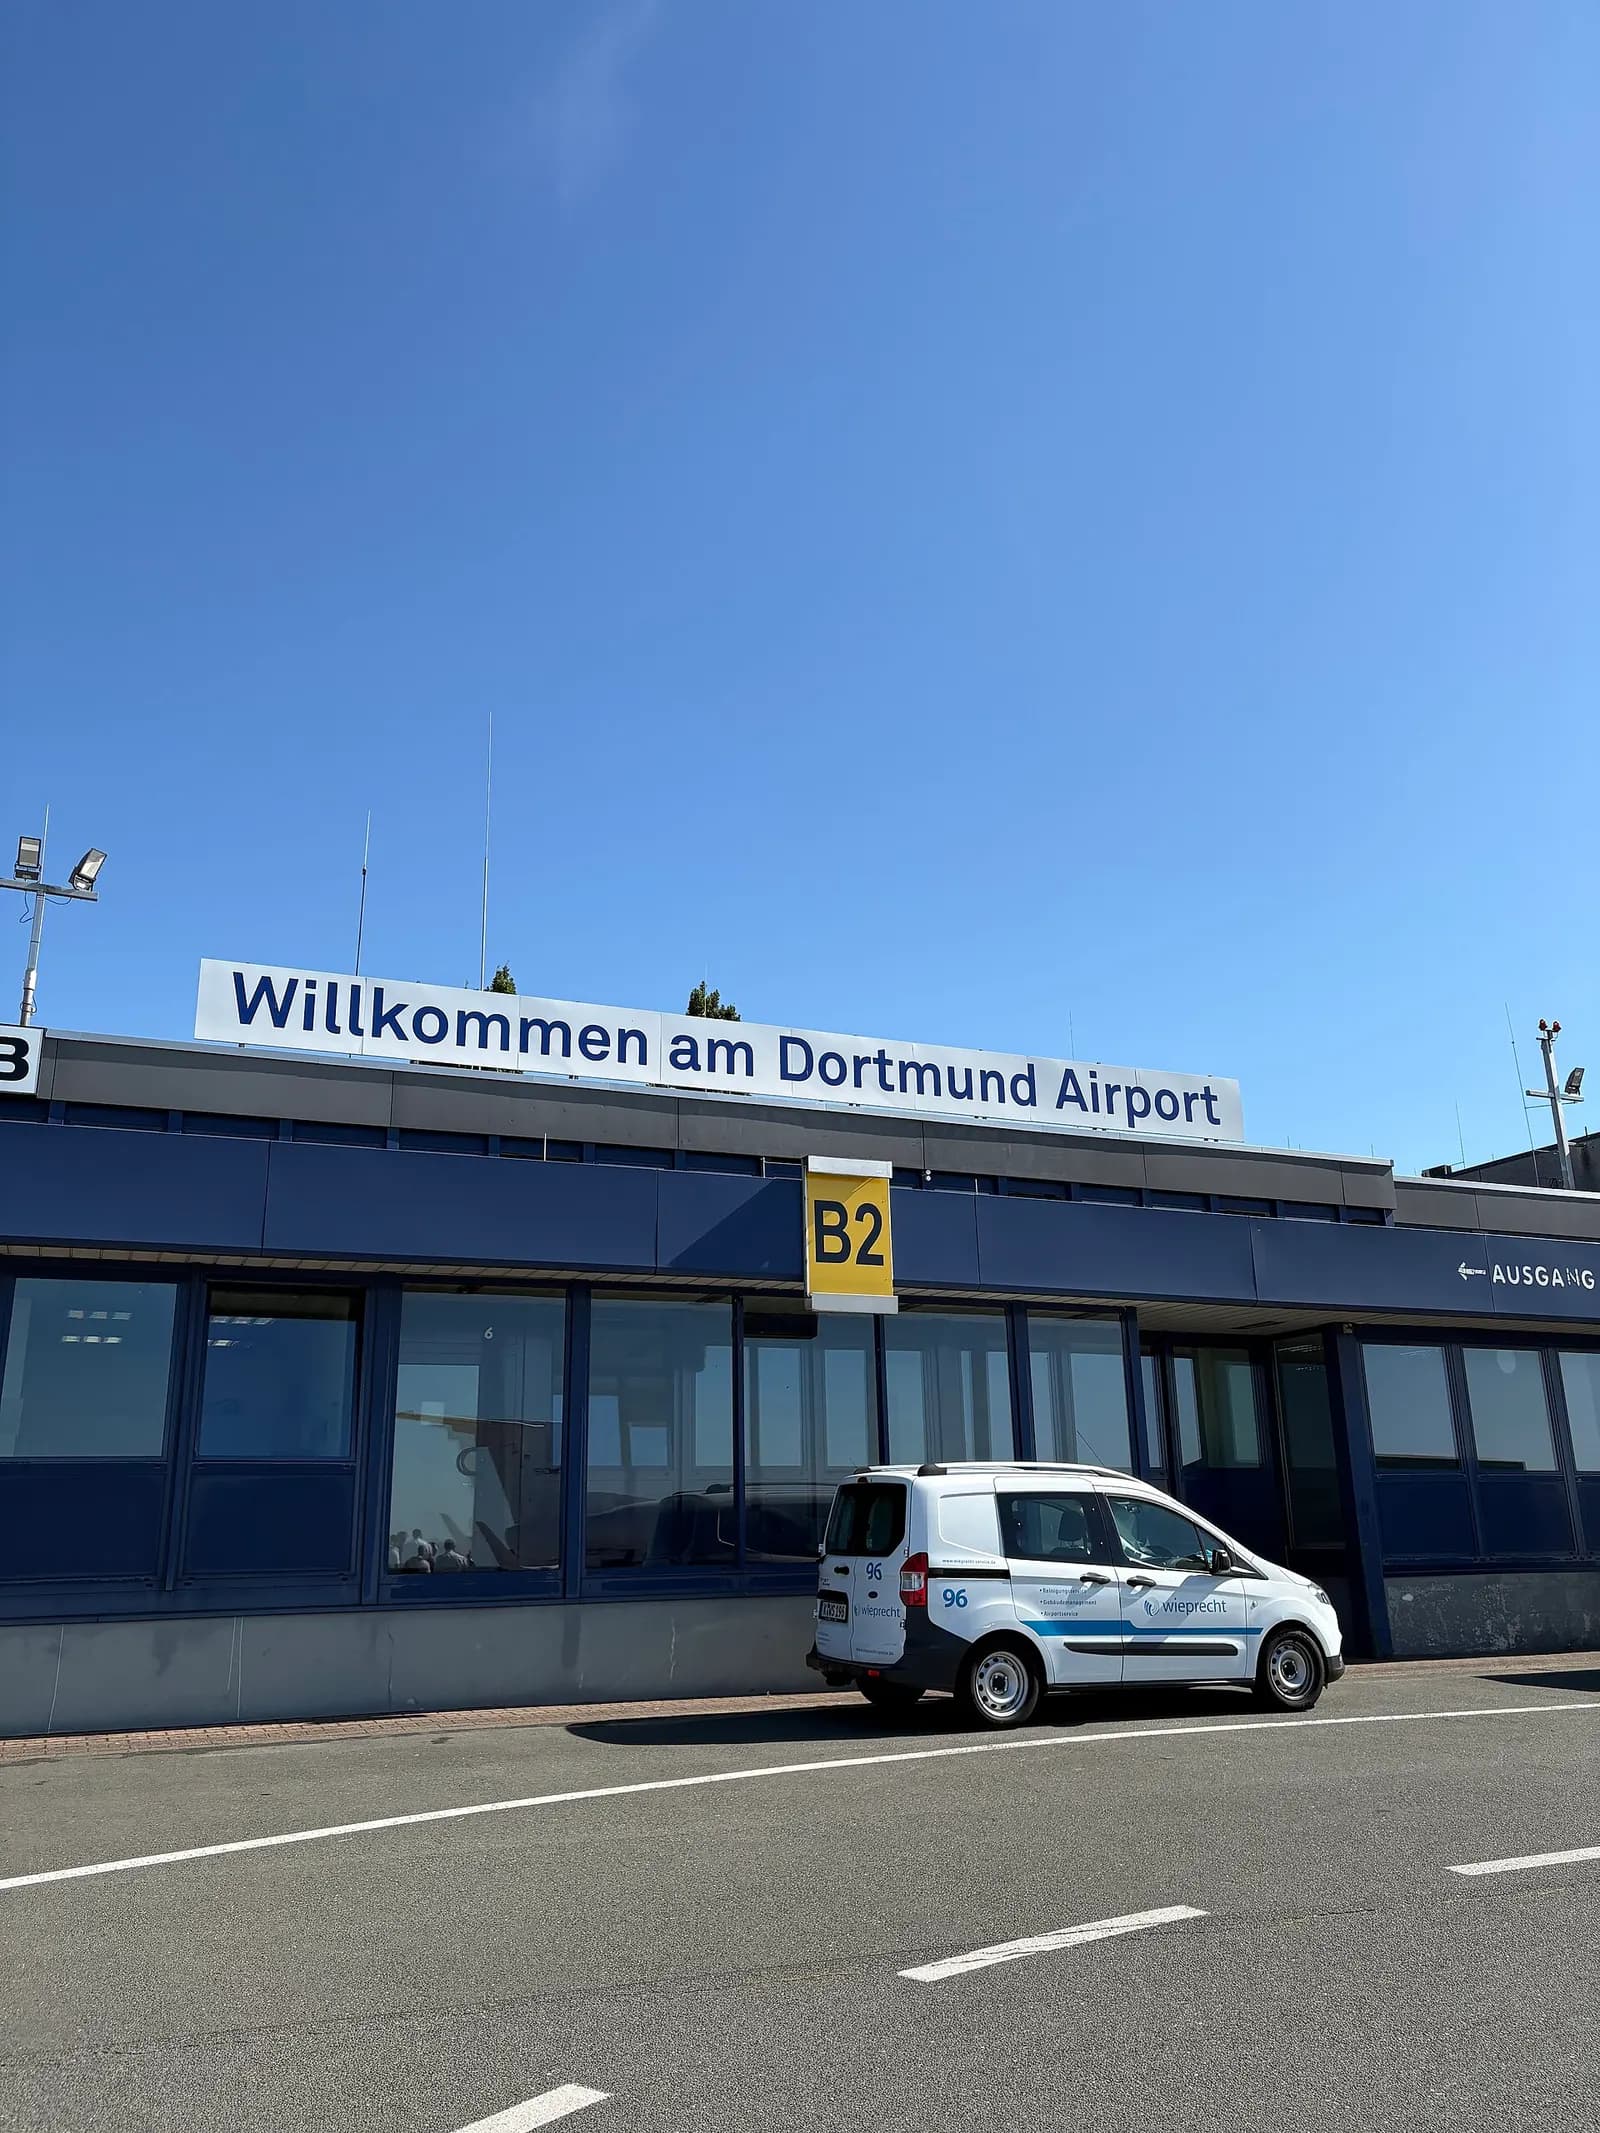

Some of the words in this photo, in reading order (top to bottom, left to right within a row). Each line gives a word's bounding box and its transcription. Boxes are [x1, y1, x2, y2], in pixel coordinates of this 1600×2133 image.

[232, 971, 648, 1066] Willkommen
[669, 1034, 754, 1077] am
[779, 1035, 1037, 1107] Dortmund
[1055, 1067, 1221, 1128] Airport
[813, 1199, 884, 1267] B2
[1492, 1264, 1596, 1290] AUSGANG
[484, 1326, 494, 1340] 6
[866, 1562, 883, 1580] 96
[942, 1588, 968, 1608] 96
[1161, 1597, 1228, 1617] wieprecht
[861, 1604, 901, 1618] wieprecht
